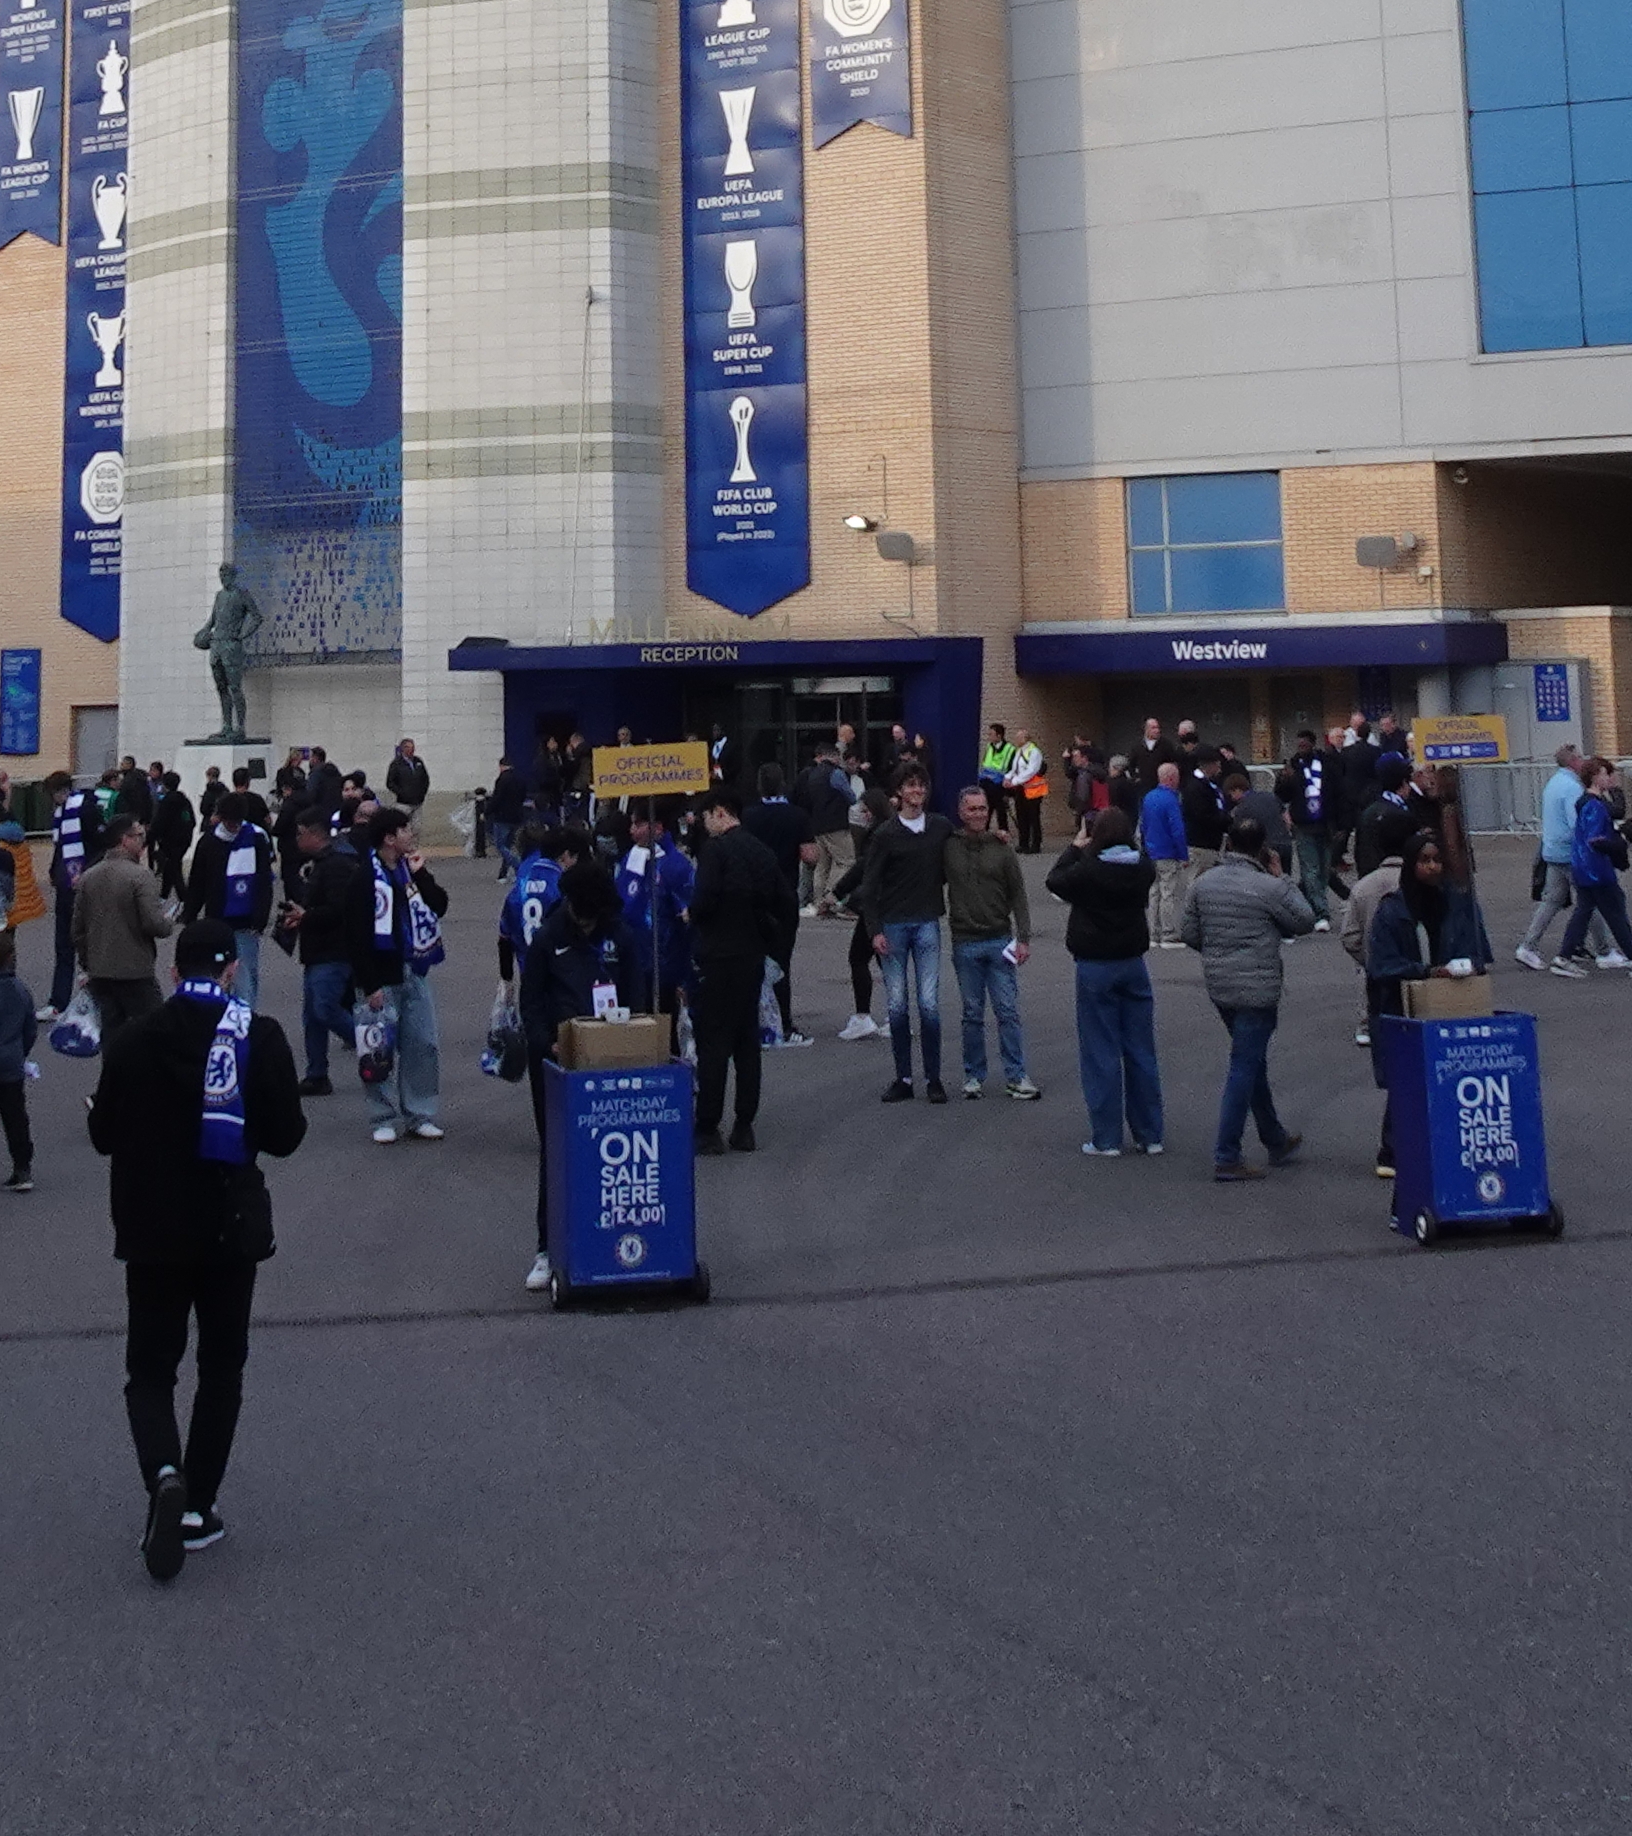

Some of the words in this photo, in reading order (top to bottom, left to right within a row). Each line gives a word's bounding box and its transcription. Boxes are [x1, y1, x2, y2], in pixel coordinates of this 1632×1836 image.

[705, 30, 745, 46] LEAGUE
[748, 27, 770, 40] CUP
[826, 45, 839, 56] FA
[841, 38, 893, 54] WOMEN'S
[826, 52, 892, 71] COMMUNITY
[840, 69, 878, 83] SHIELD
[98, 120, 109, 130] FA
[110, 117, 128, 129] CUP
[32, 172, 51, 185] CUP
[724, 179, 752, 192] UEFA
[697, 195, 741, 209] EUROPA
[742, 189, 784, 204] LEAGUE
[728, 333, 757, 345] UEFA
[713, 348, 748, 362] SUPER
[749, 346, 773, 359] CUP
[717, 489, 742, 501] FIFA
[743, 487, 772, 500] CLUB
[712, 504, 752, 516] WORLD
[754, 502, 778, 514] CUP
[74, 530, 86, 541] FA
[641, 646, 738, 663] RECEPTION
[1172, 639, 1267, 662] Westview
[616, 755, 684, 770] OFFICIAL
[598, 768, 704, 786] PROGRAMMES
[1457, 1074, 1511, 1108] ON
[592, 1095, 668, 1113] MATCHDAY
[578, 1109, 681, 1128] PROGRAMMES
[1459, 1106, 1511, 1129] SALE
[1460, 1126, 1513, 1147] HERE
[599, 1129, 658, 1165] ON
[600, 1163, 659, 1188] SALE
[600, 1184, 659, 1208] HERE
